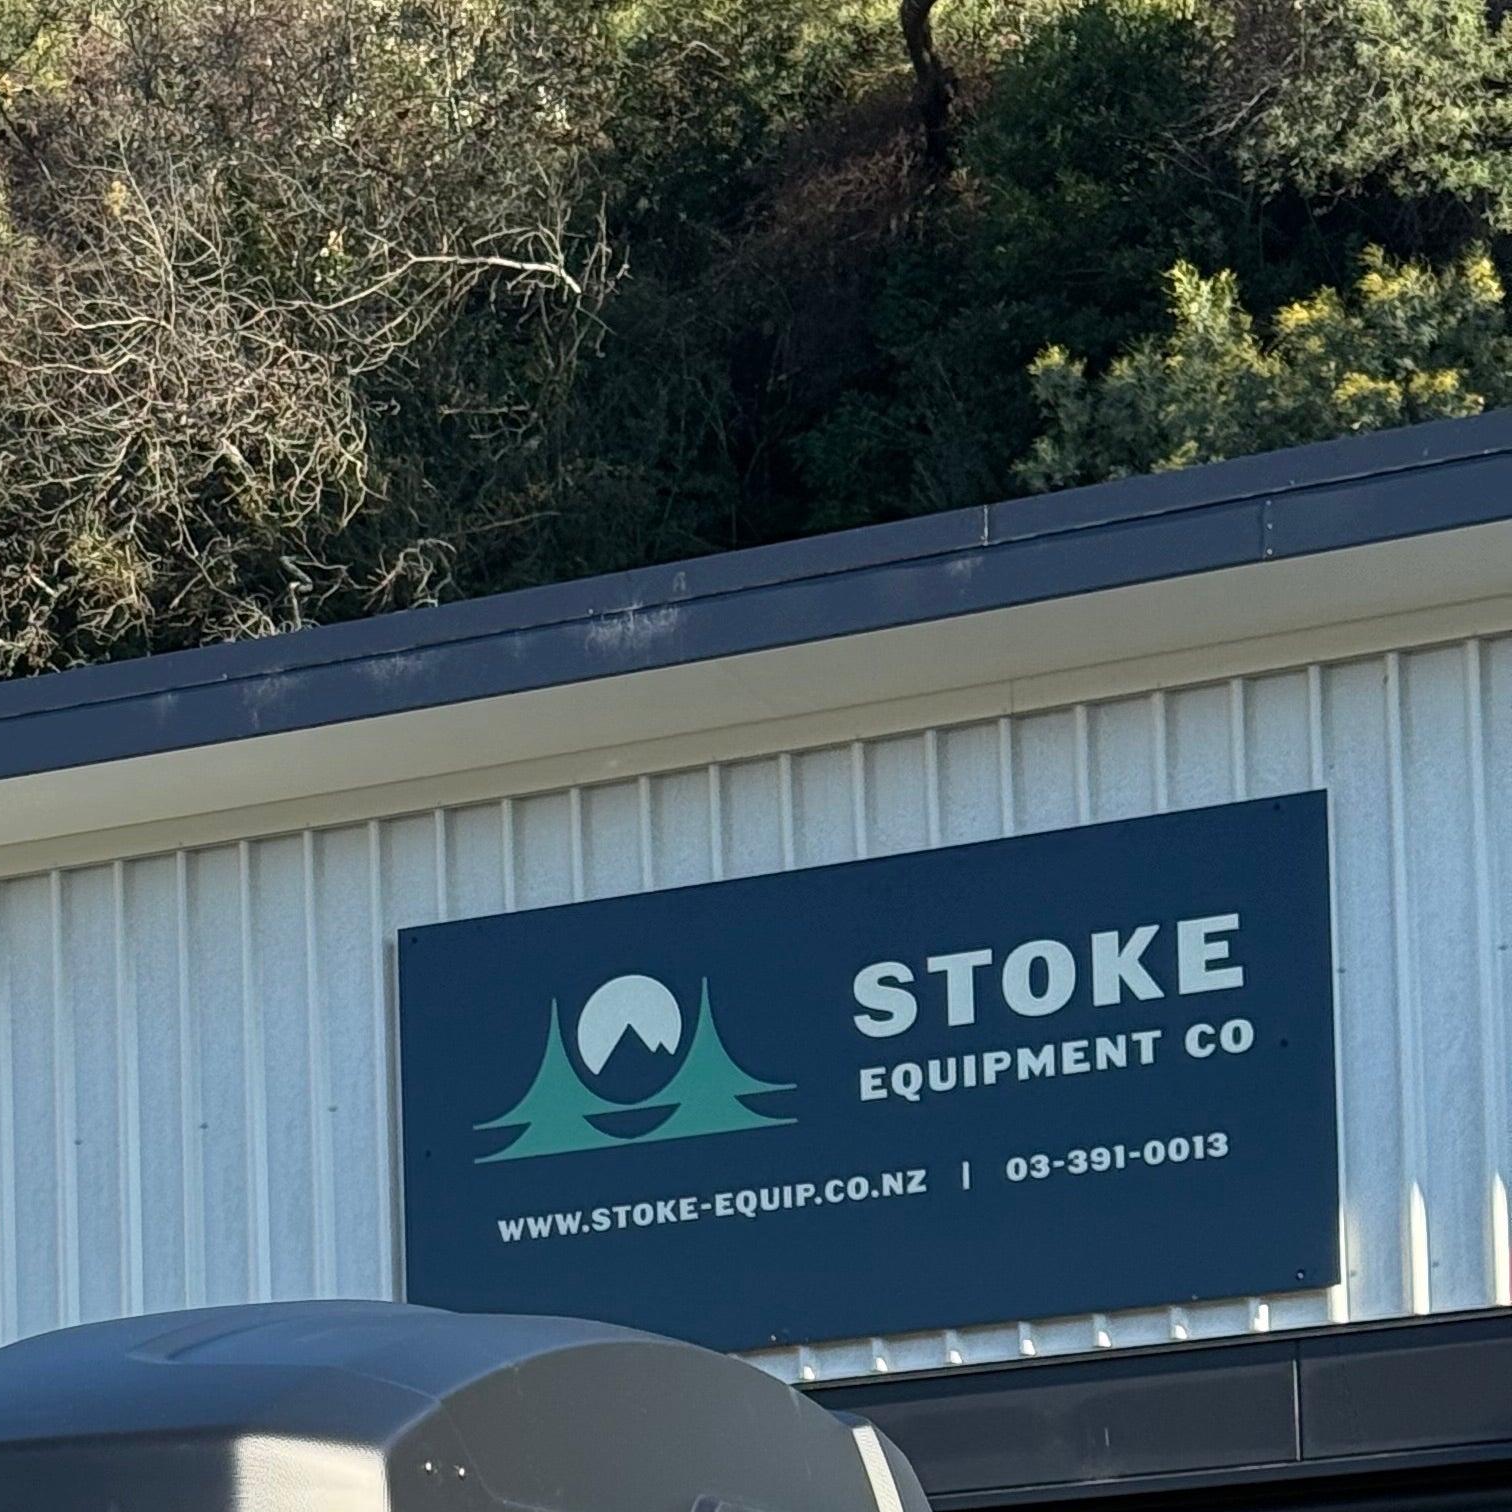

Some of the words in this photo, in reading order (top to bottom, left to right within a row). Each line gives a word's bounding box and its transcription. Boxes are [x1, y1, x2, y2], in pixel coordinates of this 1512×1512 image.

[852, 912, 1245, 1038] STOKE
[859, 1029, 1163, 1102] EQUIPMENT
[1184, 1018, 1255, 1059] CO
[496, 1168, 928, 1243] WWW.STOKE-EQUIP.CO.NZ
[1005, 1131, 1230, 1182] 03-391-0013
